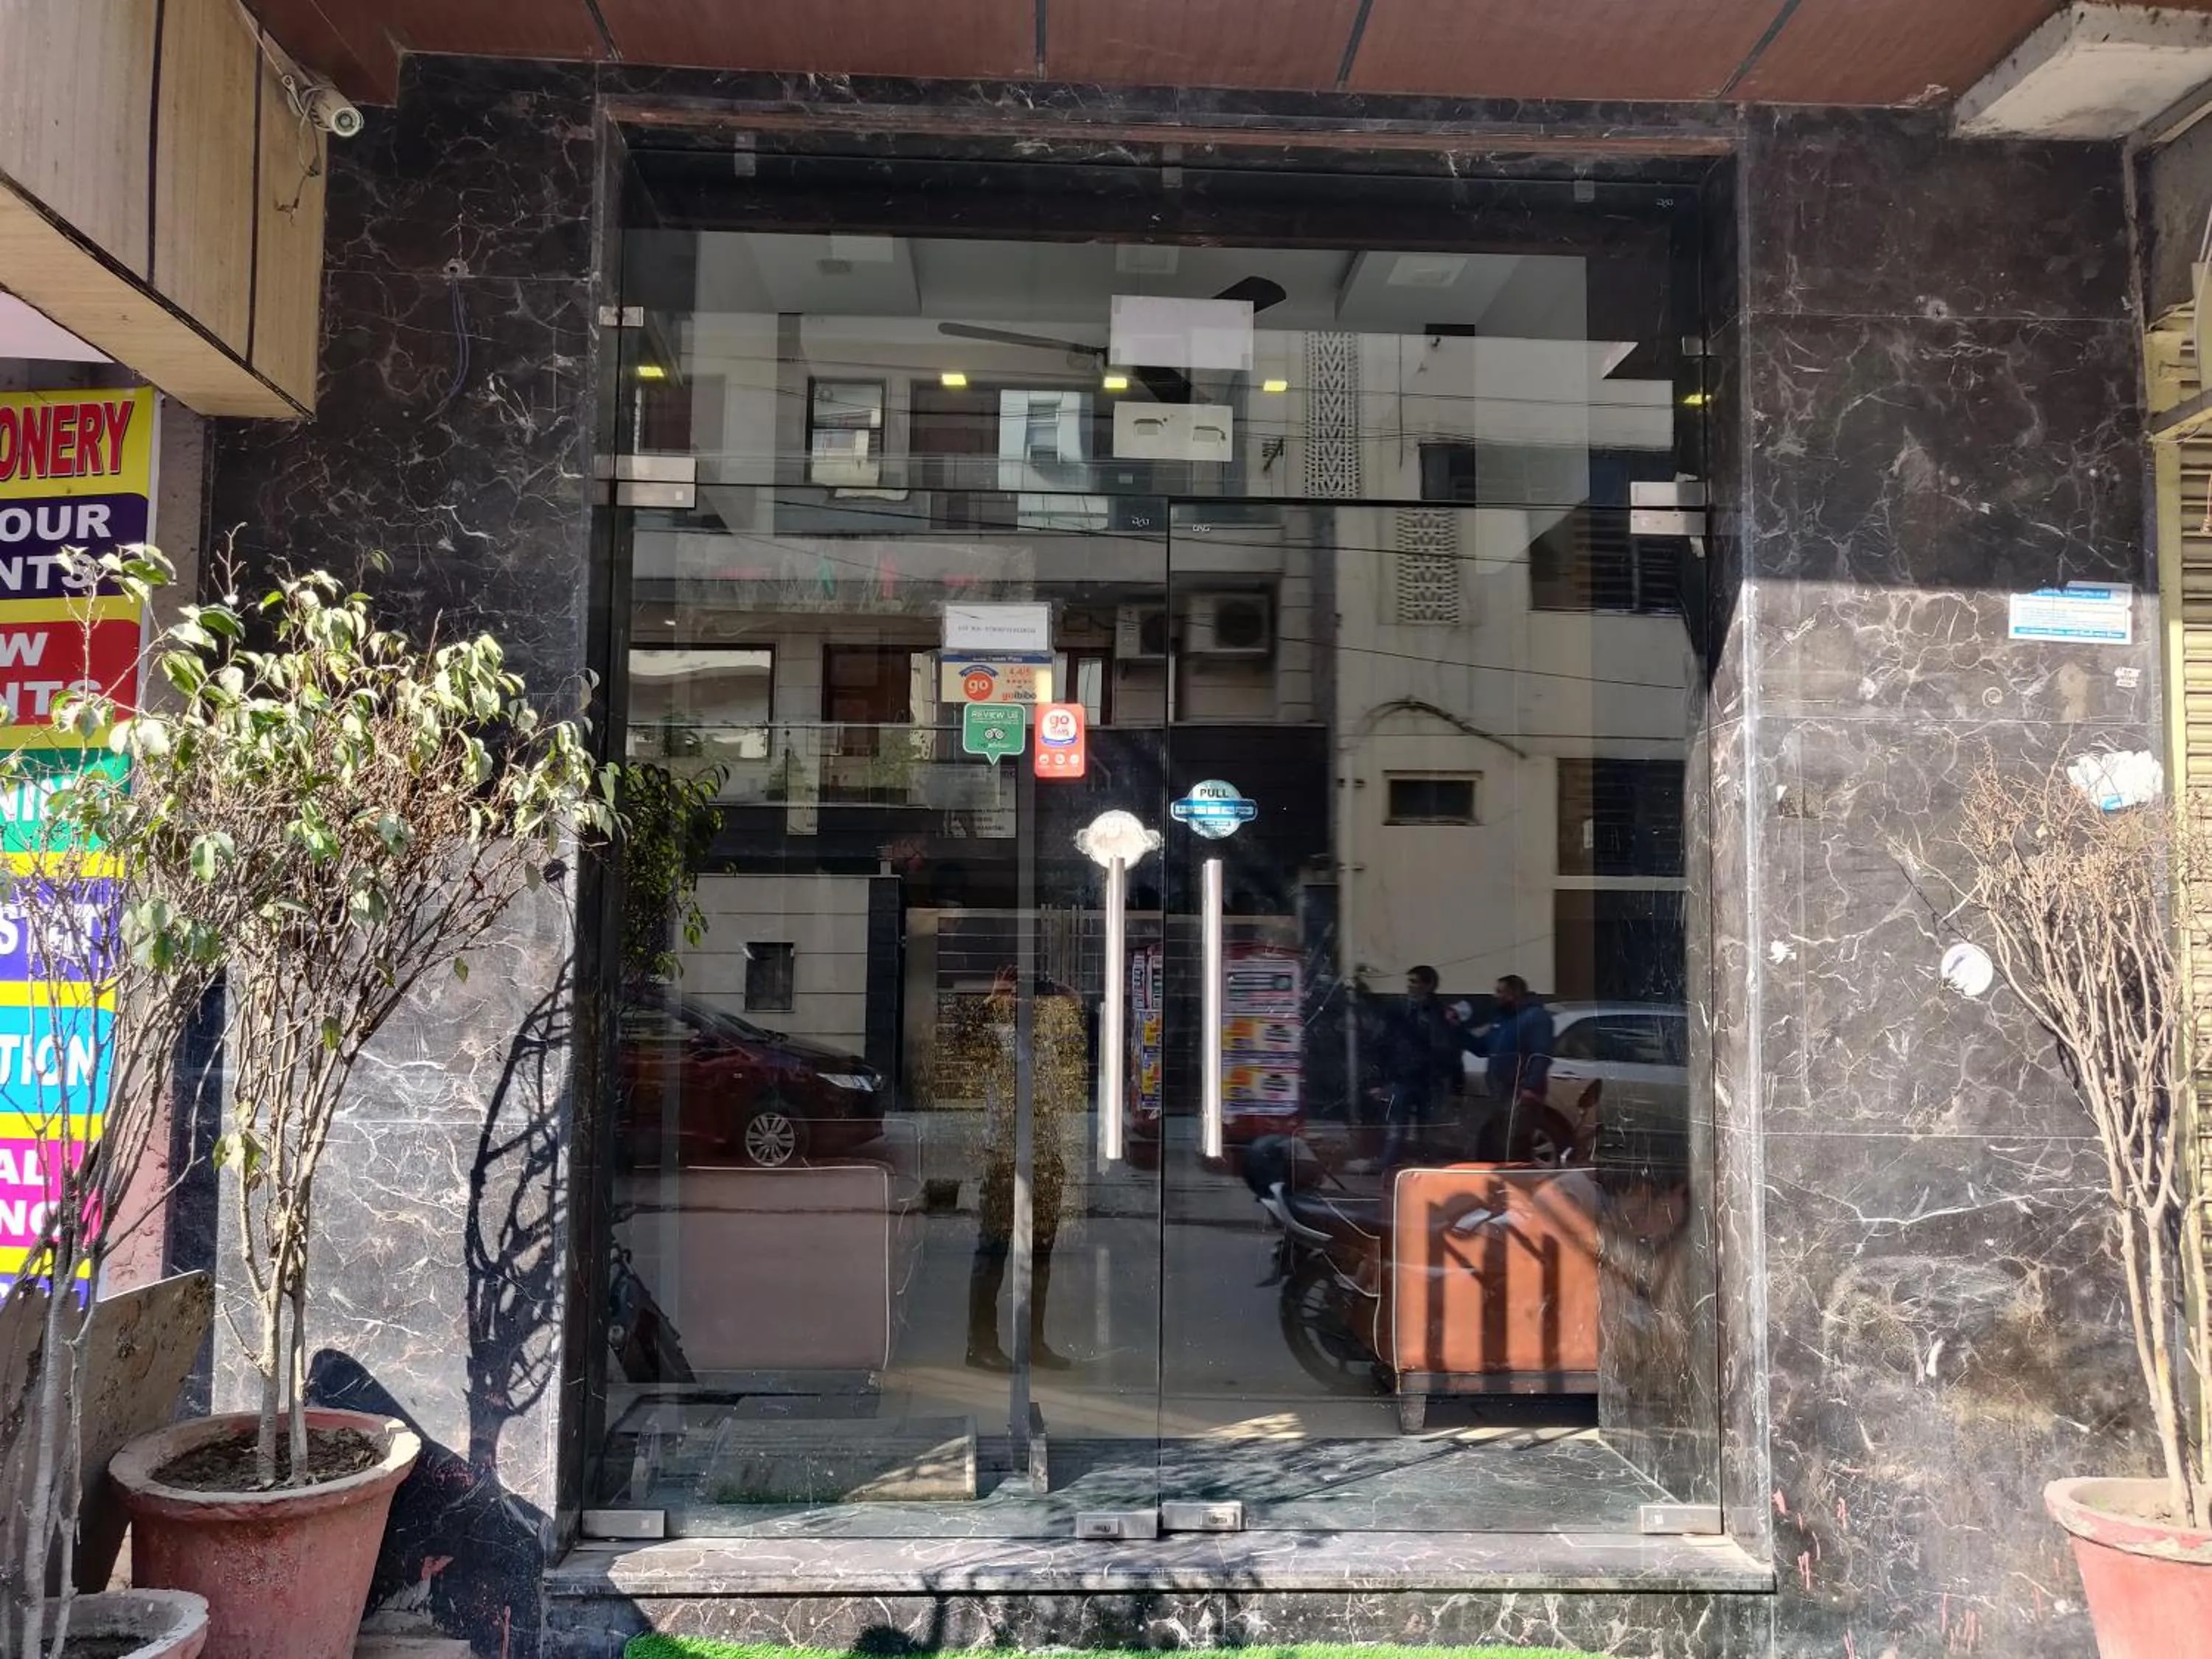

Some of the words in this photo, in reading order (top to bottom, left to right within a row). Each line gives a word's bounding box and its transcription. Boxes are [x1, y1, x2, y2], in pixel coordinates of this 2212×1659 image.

[0, 400, 135, 481] ONERY
[0, 503, 111, 542] OUR
[968, 679, 989, 694] go
[972, 710, 1004, 719] REVIEW
[1200, 788, 1229, 798] PULL
[0, 1034, 95, 1086] TION
